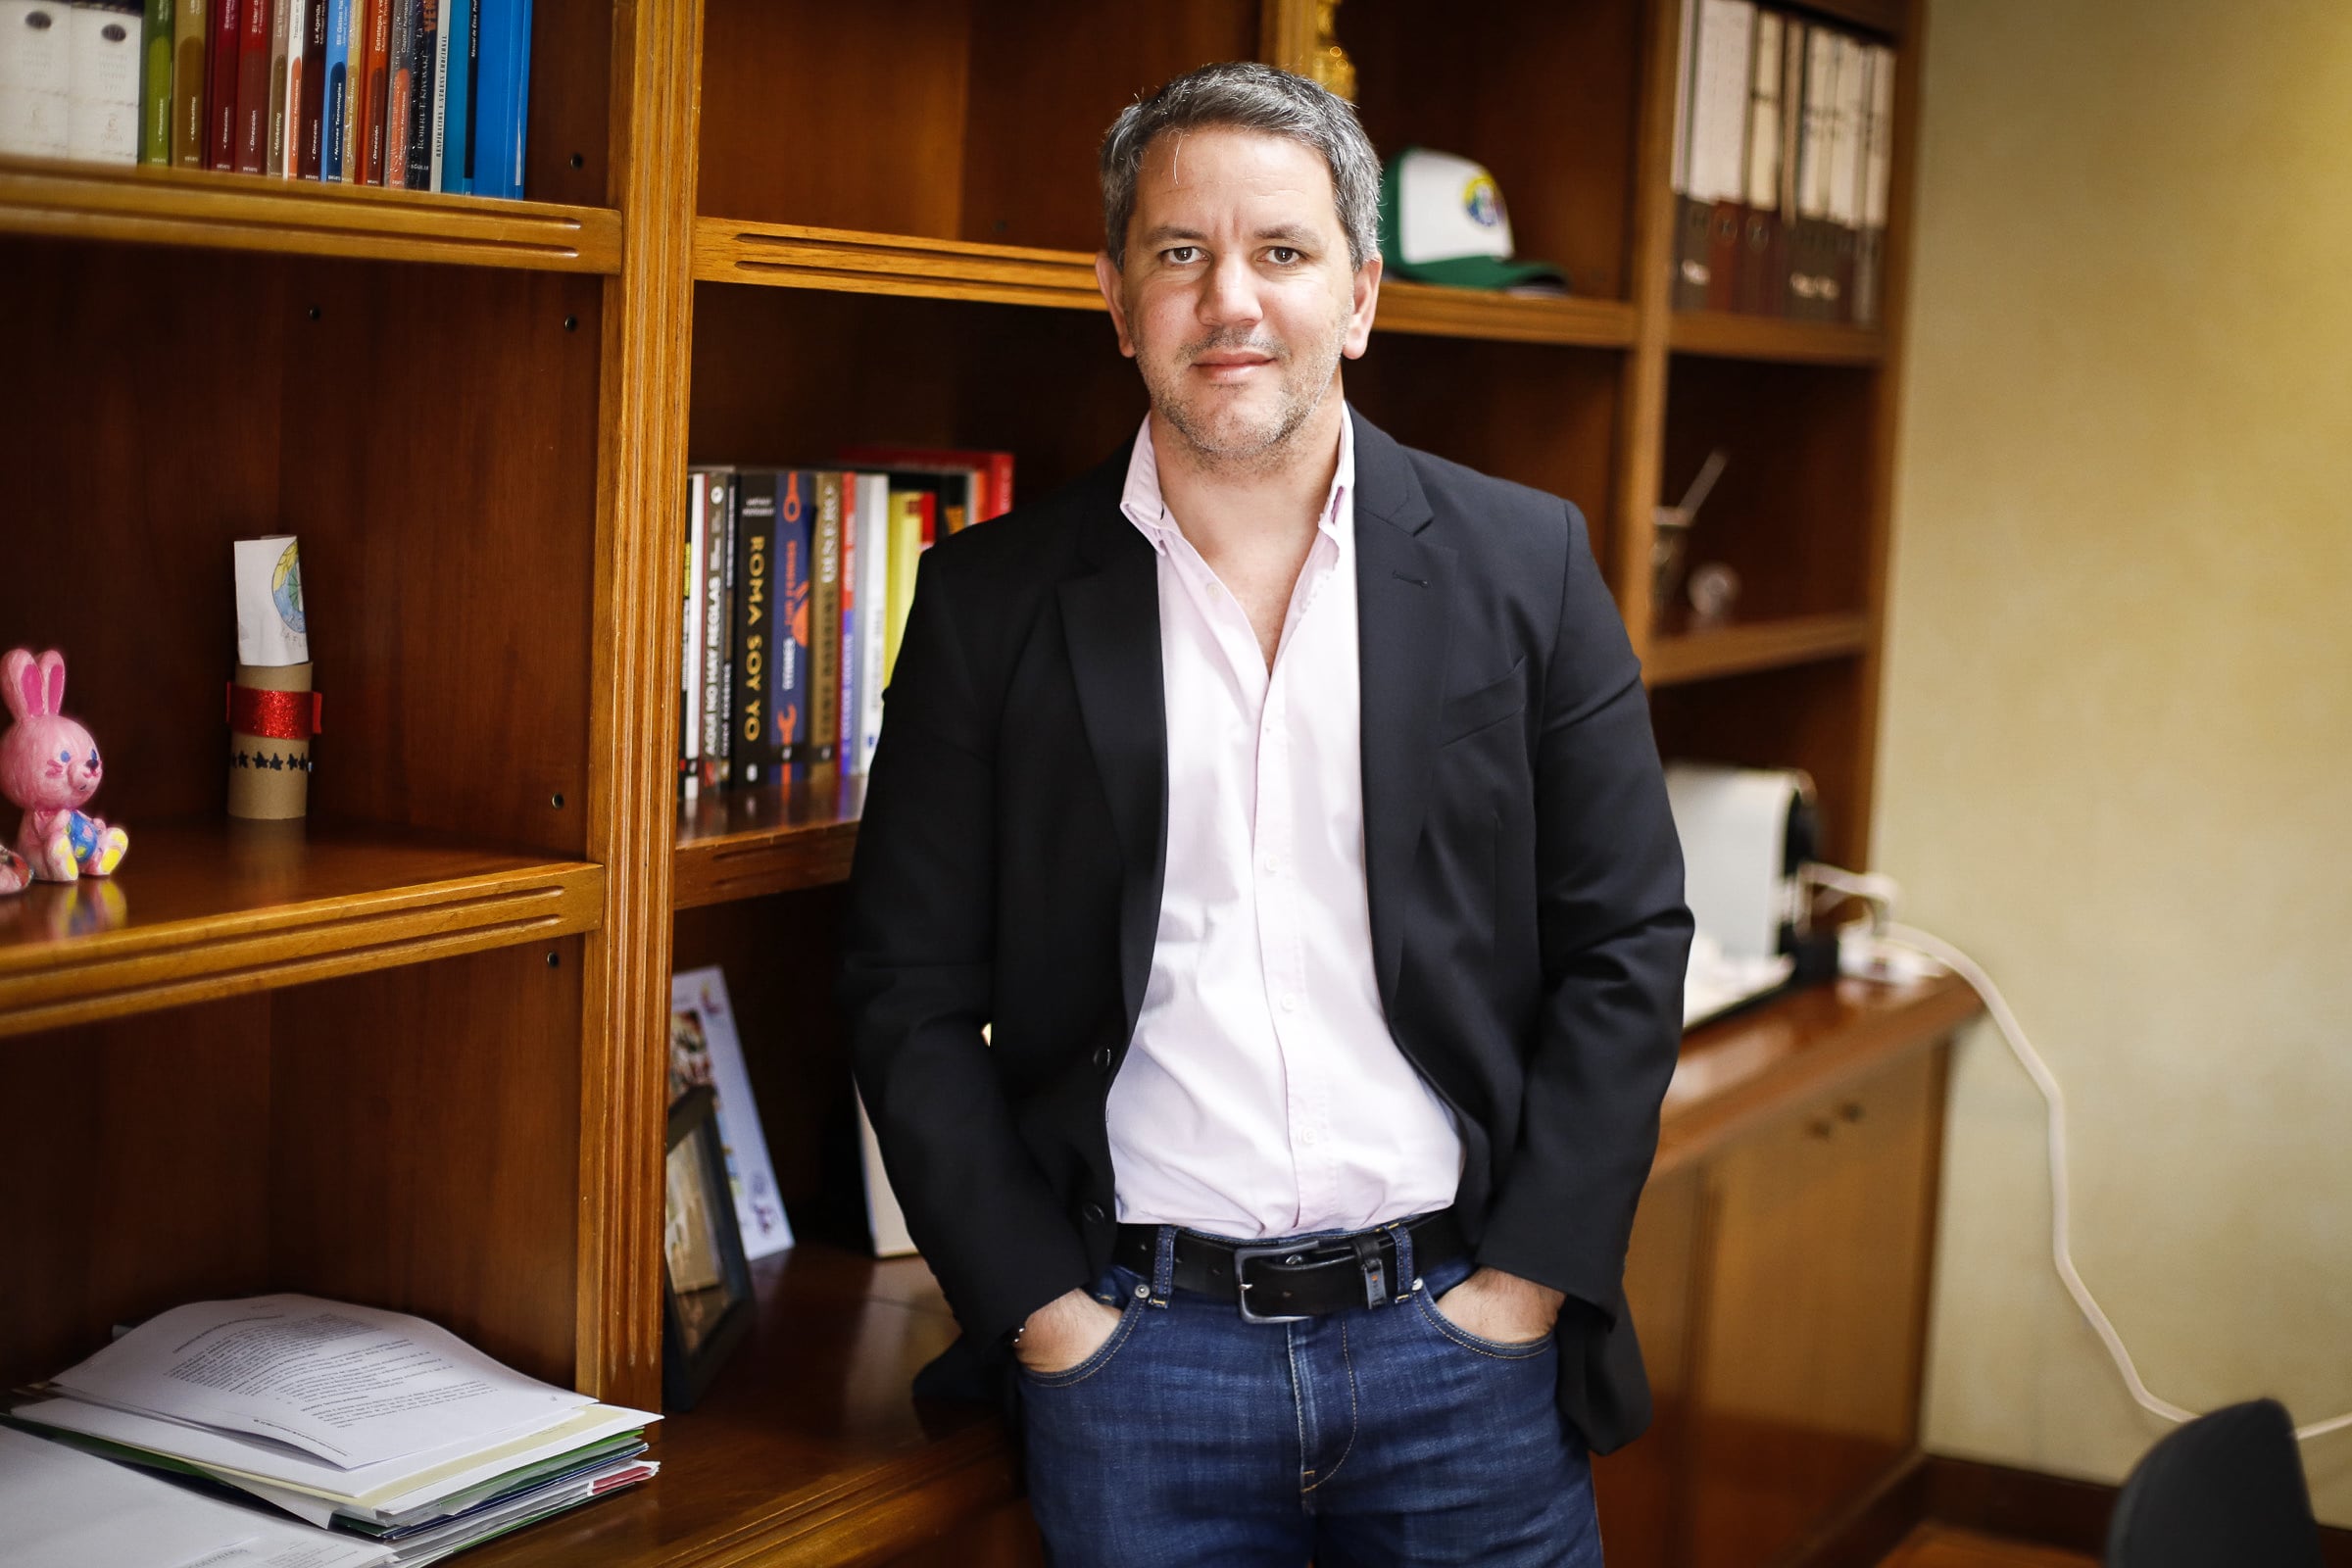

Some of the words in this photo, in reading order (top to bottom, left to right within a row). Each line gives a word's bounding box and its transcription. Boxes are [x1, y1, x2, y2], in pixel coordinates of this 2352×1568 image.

[747, 535, 765, 626] ROMA
[707, 575, 721, 648] REGLAS
[745, 634, 762, 692] SOY
[706, 683, 719, 712] NO
[744, 699, 761, 742] YO
